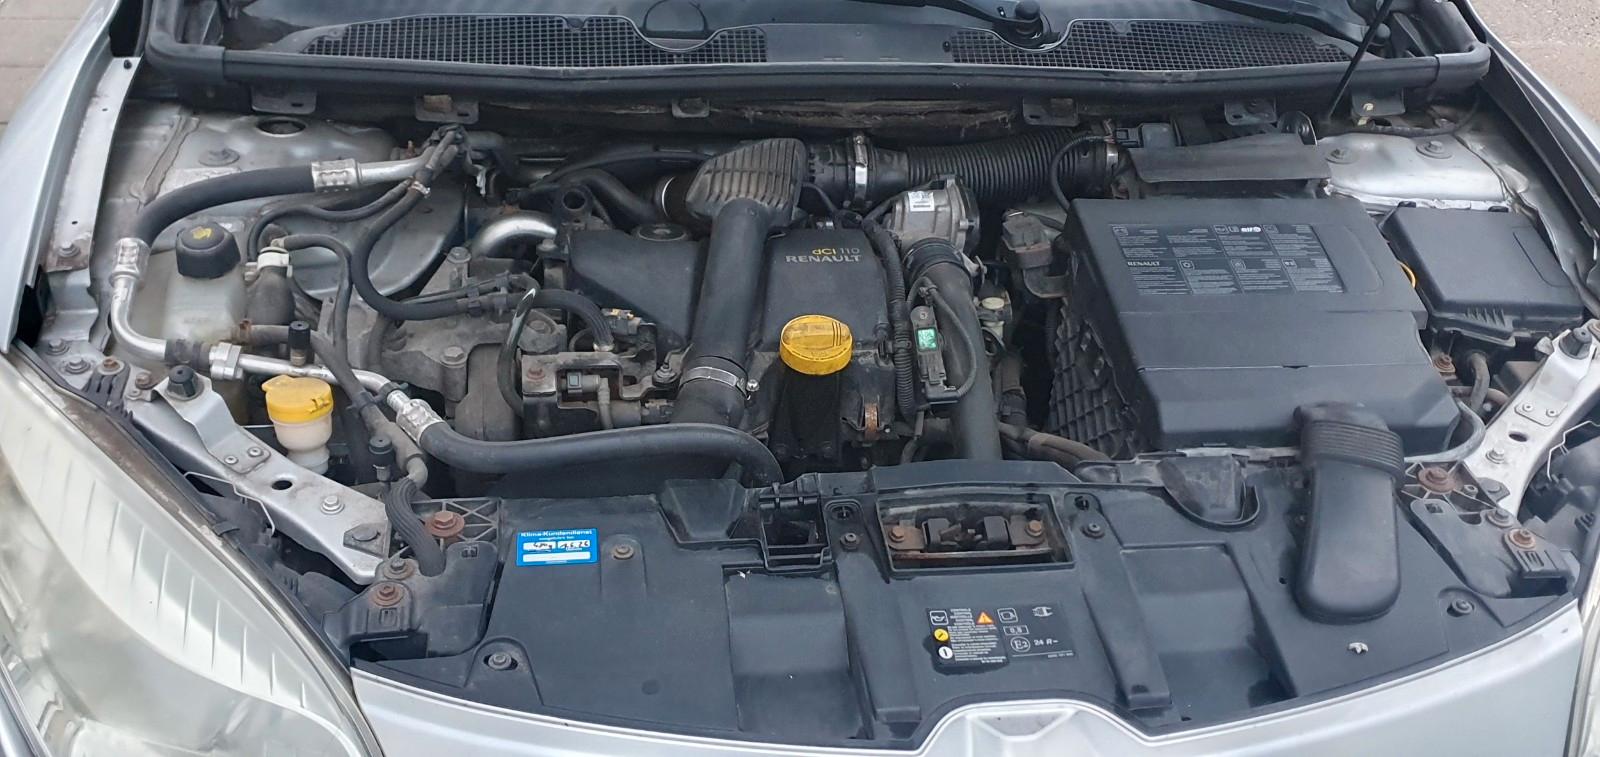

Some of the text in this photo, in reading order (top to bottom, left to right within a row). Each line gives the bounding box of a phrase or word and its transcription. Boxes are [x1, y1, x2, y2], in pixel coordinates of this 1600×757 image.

[840, 247, 860, 255] 110
[785, 255, 861, 263] RENAULT
[521, 529, 592, 537] Klima-Kundendienst
